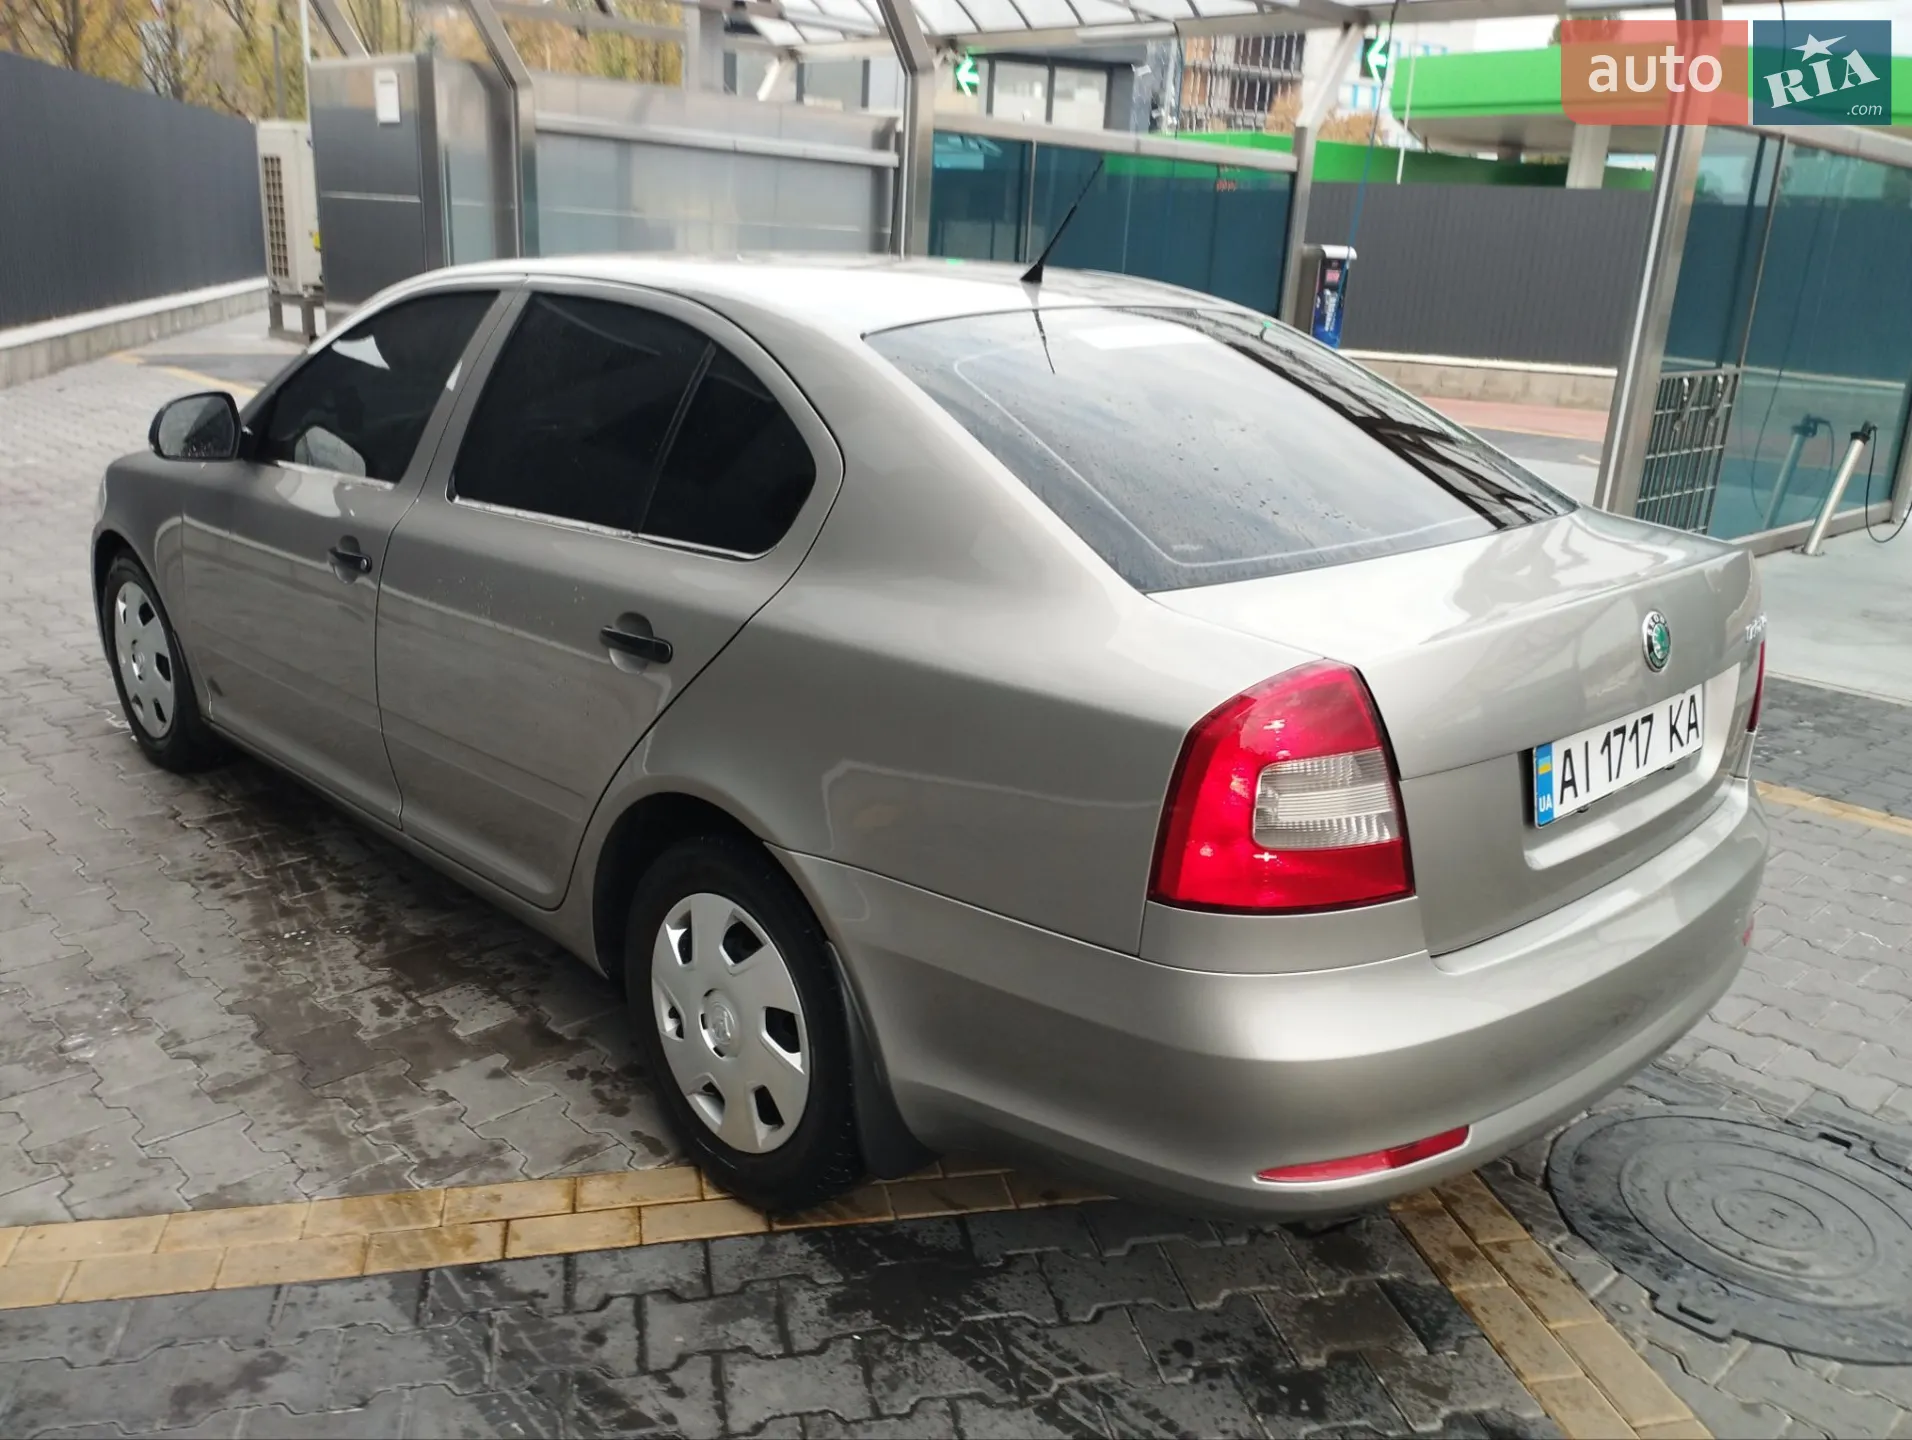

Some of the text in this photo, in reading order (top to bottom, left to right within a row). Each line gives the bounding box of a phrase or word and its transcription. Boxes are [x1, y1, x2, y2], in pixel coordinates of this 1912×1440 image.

[1559, 694, 1700, 805] AI 1717 KA
[1539, 794, 1552, 812] UA
